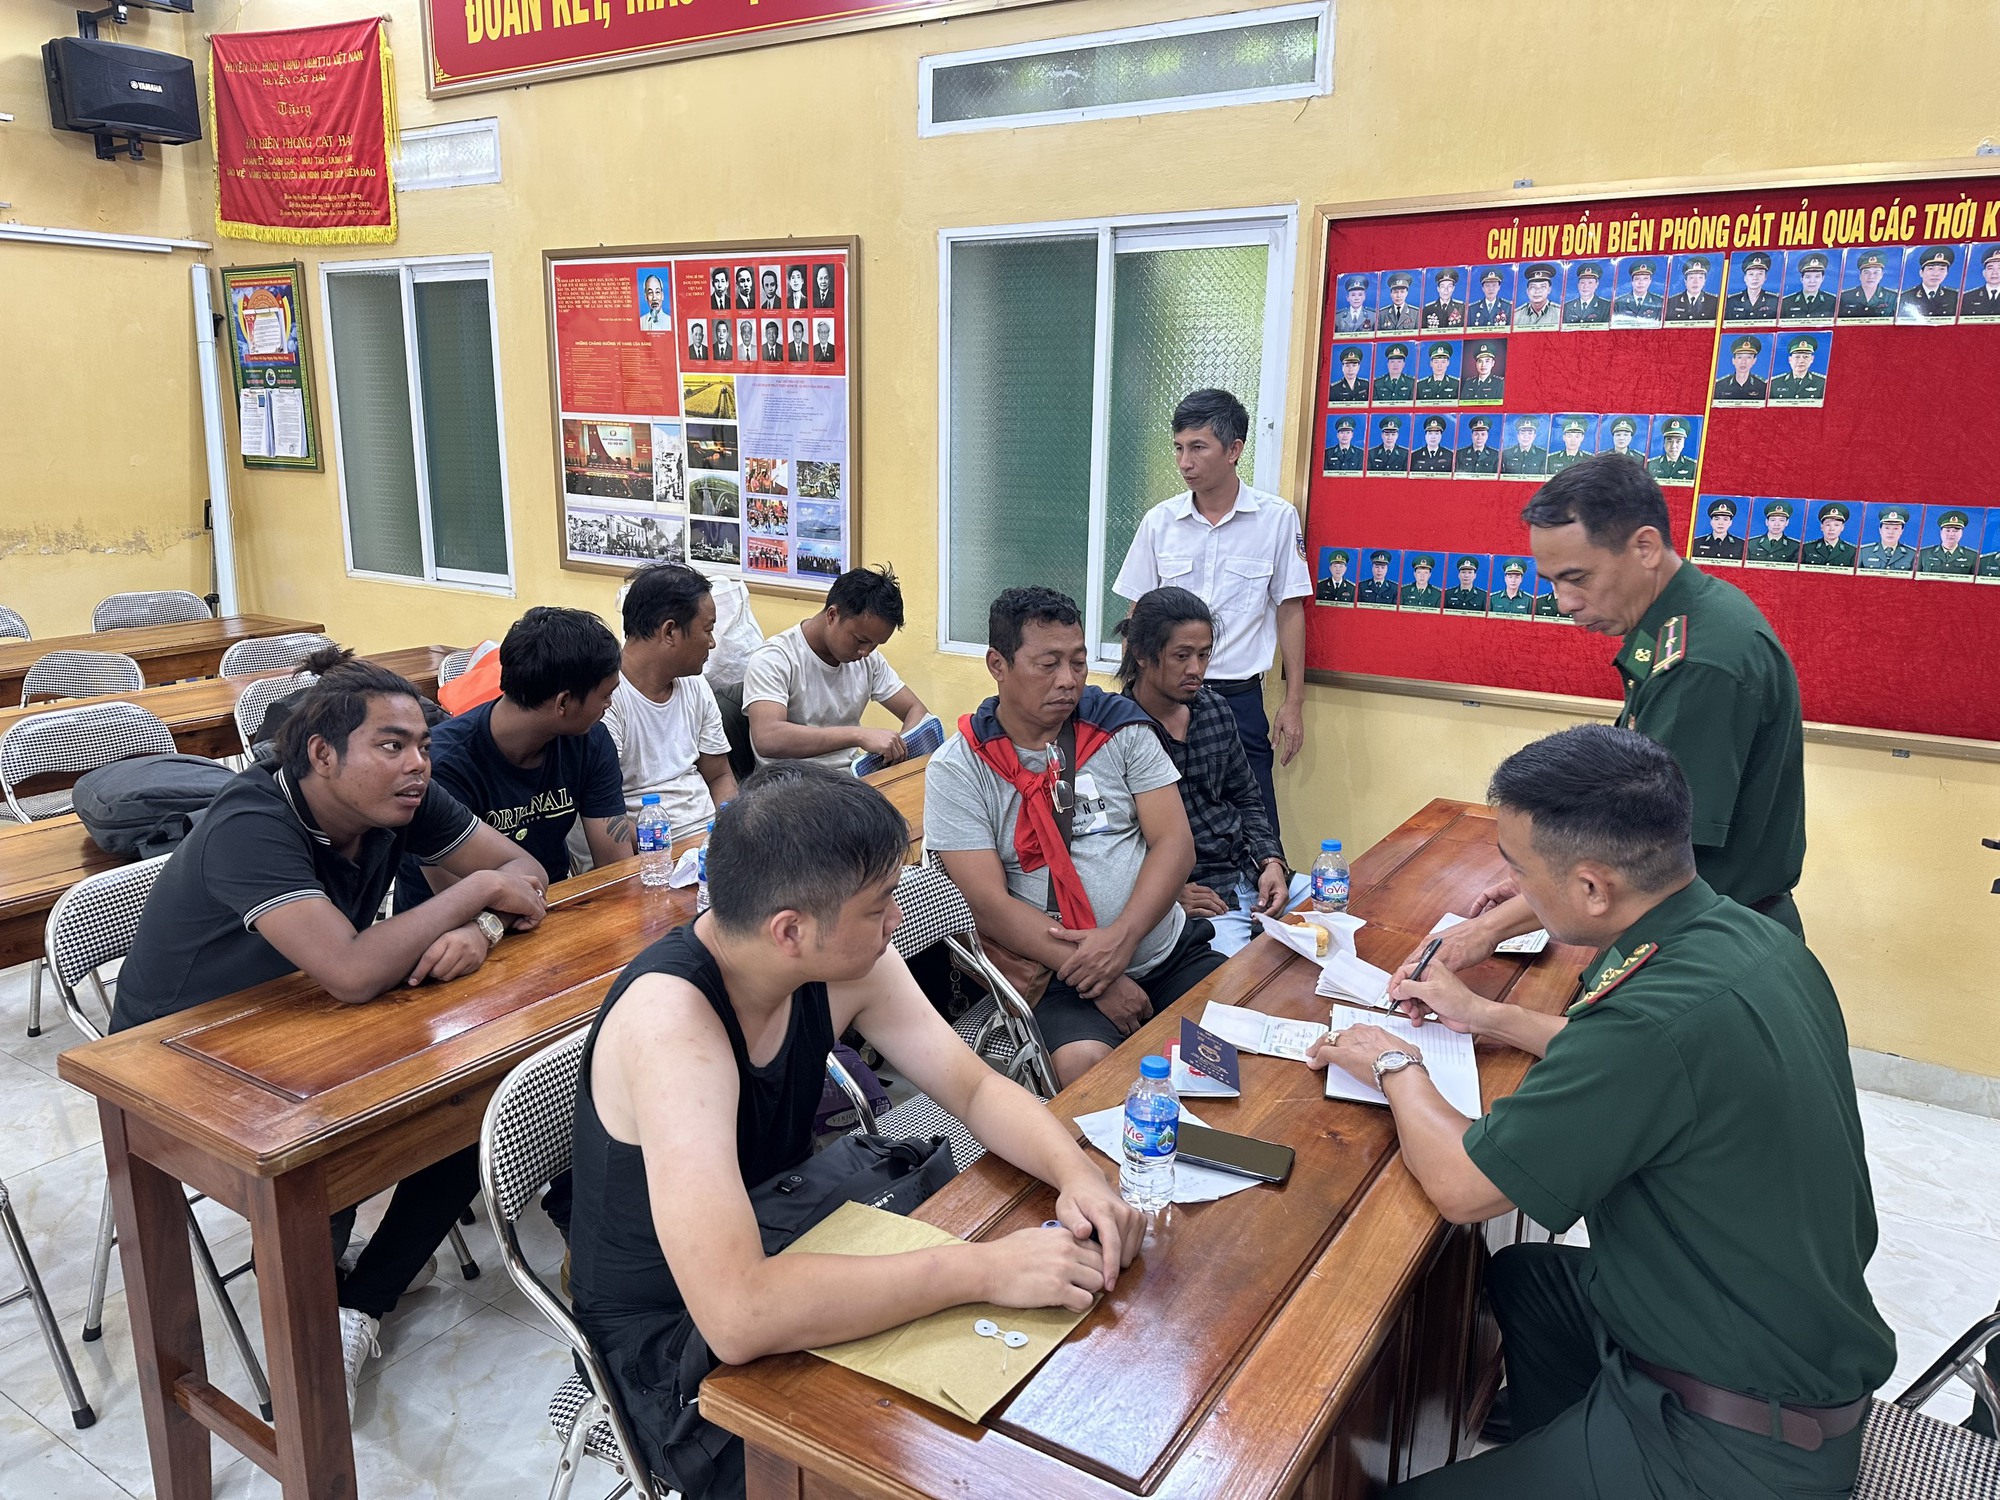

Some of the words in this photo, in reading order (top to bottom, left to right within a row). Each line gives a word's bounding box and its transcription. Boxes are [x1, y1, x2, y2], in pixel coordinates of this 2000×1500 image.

[348, 49, 364, 62] NAM
[137, 81, 163, 93] YAMAHA
[1487, 217, 1520, 260] CHỈ
[1521, 224, 1559, 258] HUY
[1561, 210, 1603, 256] ĐỒN
[1607, 212, 1654, 254] BIÊN
[1658, 208, 1730, 251] PHÒNG
[1733, 205, 1775, 248] CÁT
[1778, 198, 1817, 245] HẢI
[1821, 207, 1865, 248] QUA
[1869, 198, 1917, 243] CÁC
[1923, 192, 1977, 239] THỜI
